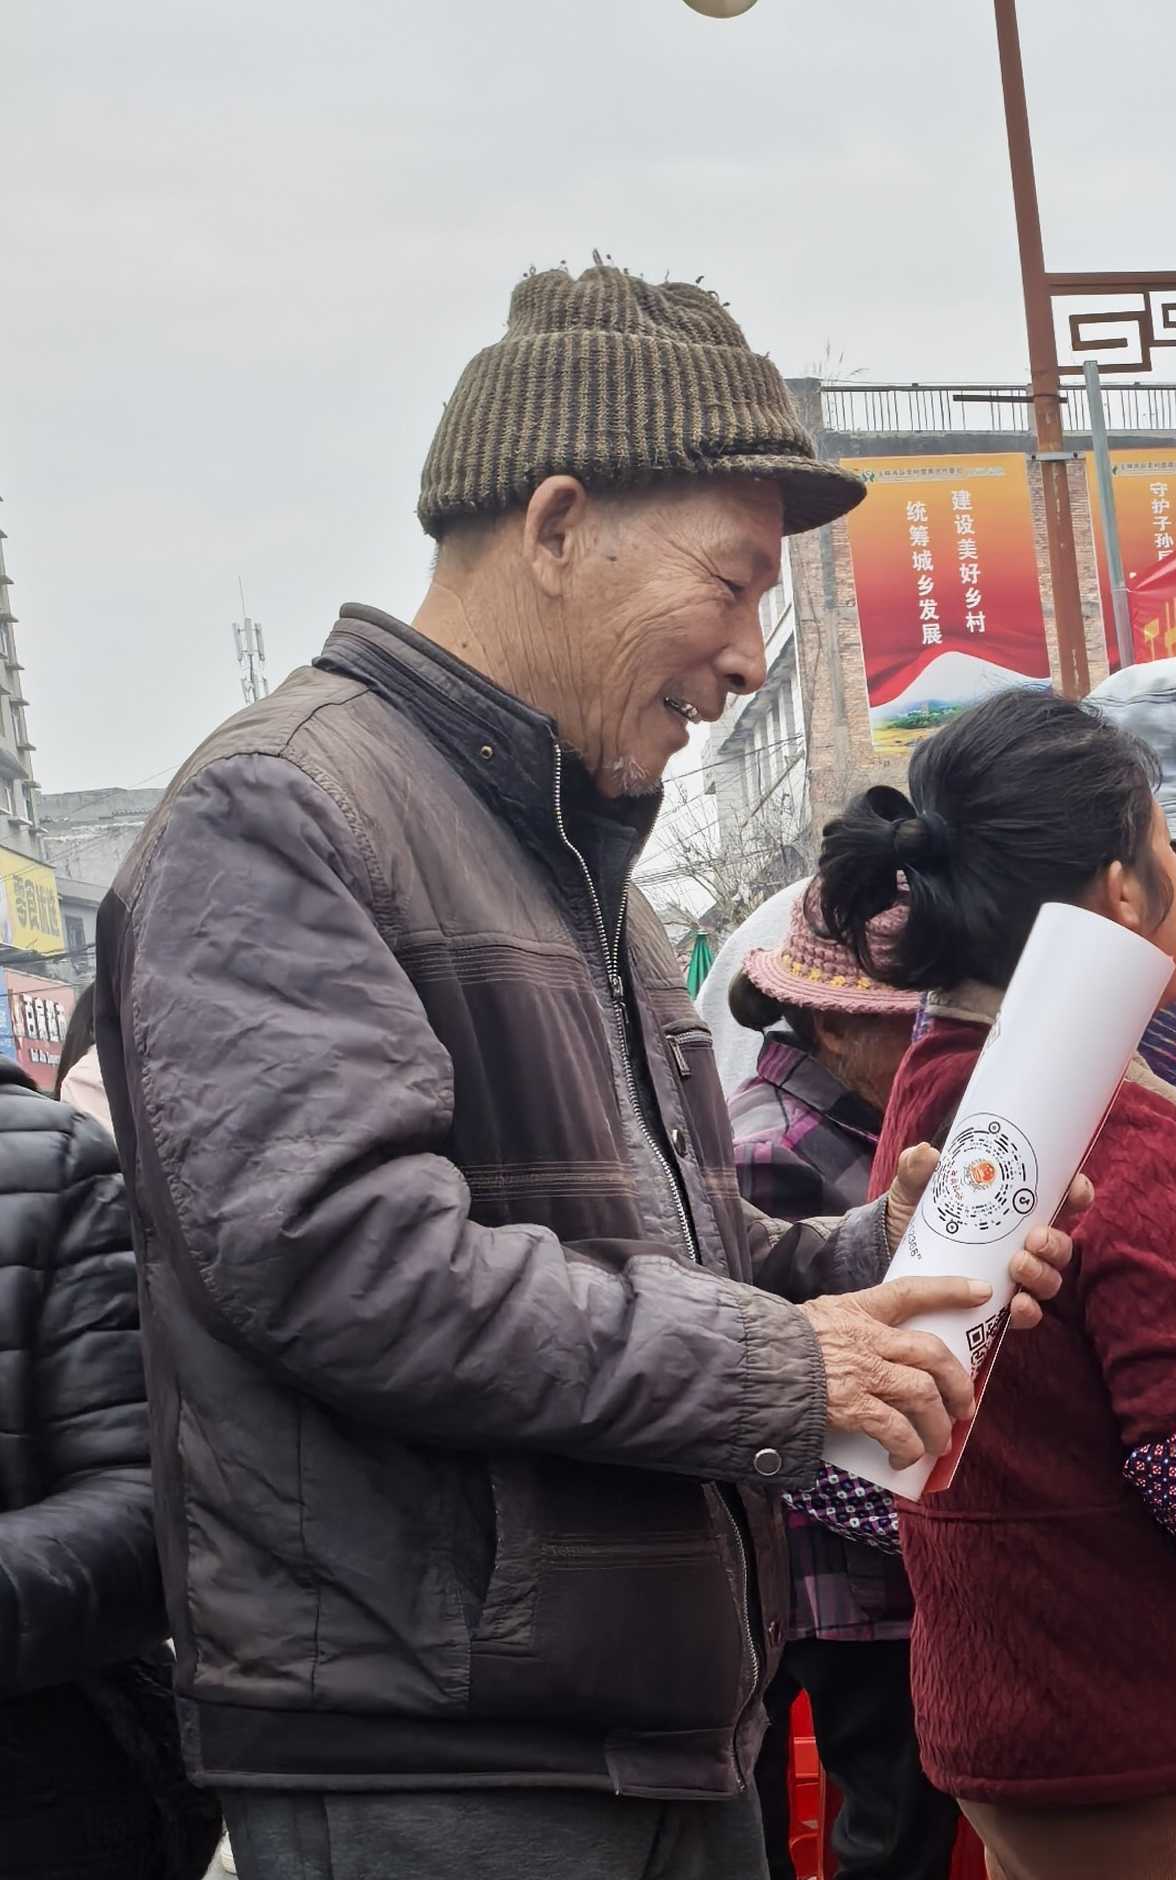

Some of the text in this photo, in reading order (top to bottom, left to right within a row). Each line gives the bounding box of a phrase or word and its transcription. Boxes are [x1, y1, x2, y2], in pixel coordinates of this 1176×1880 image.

[906, 501, 943, 645] 统筹城乡发展
[951, 489, 986, 633] 建设美好乡村
